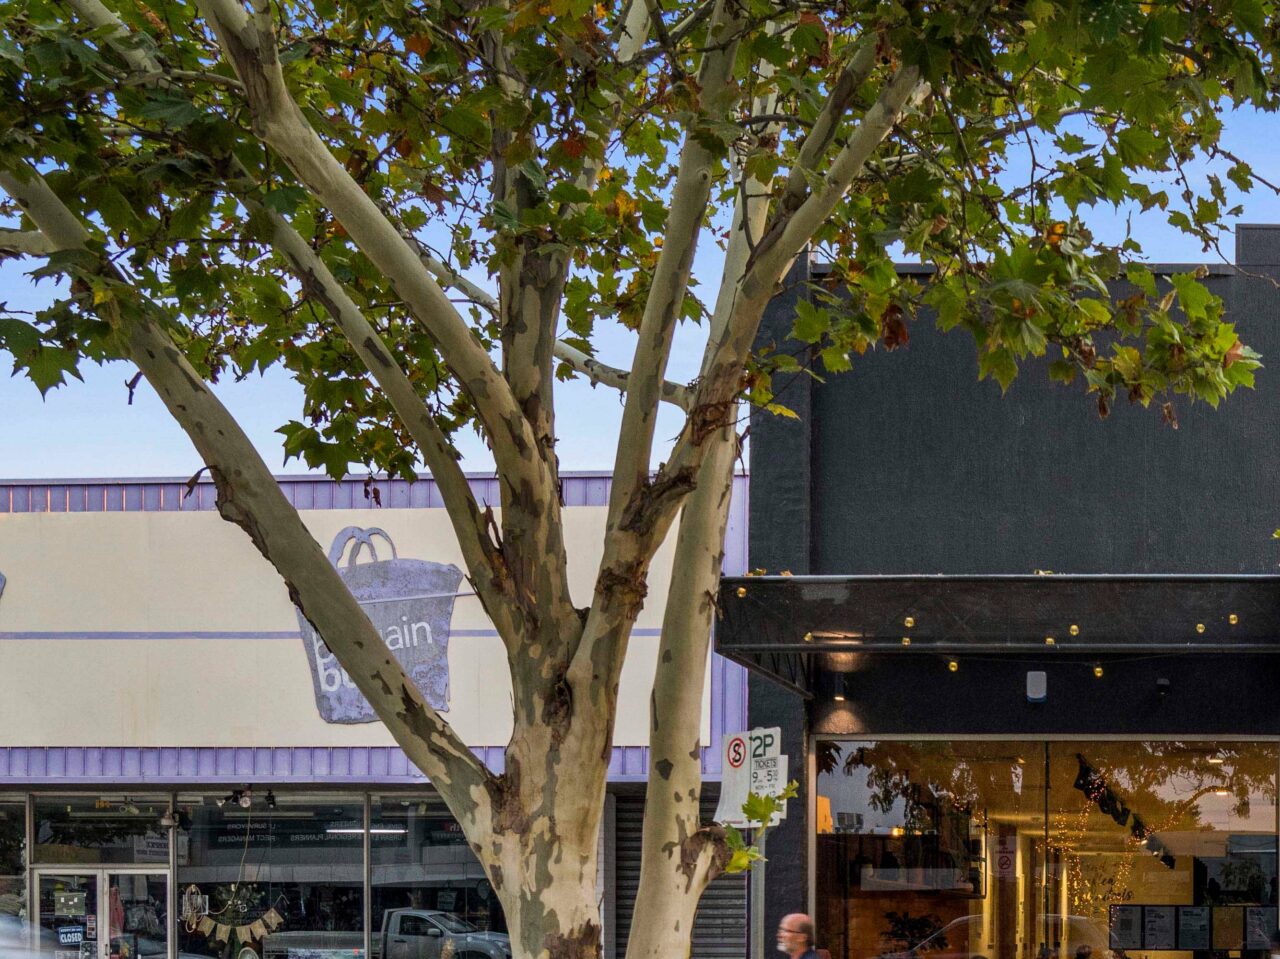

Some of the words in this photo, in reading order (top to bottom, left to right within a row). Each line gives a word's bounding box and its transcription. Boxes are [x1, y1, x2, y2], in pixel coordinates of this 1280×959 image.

[312, 615, 433, 665] bain
[752, 734, 774, 758] 2P
[60, 932, 82, 943] CLOSED
